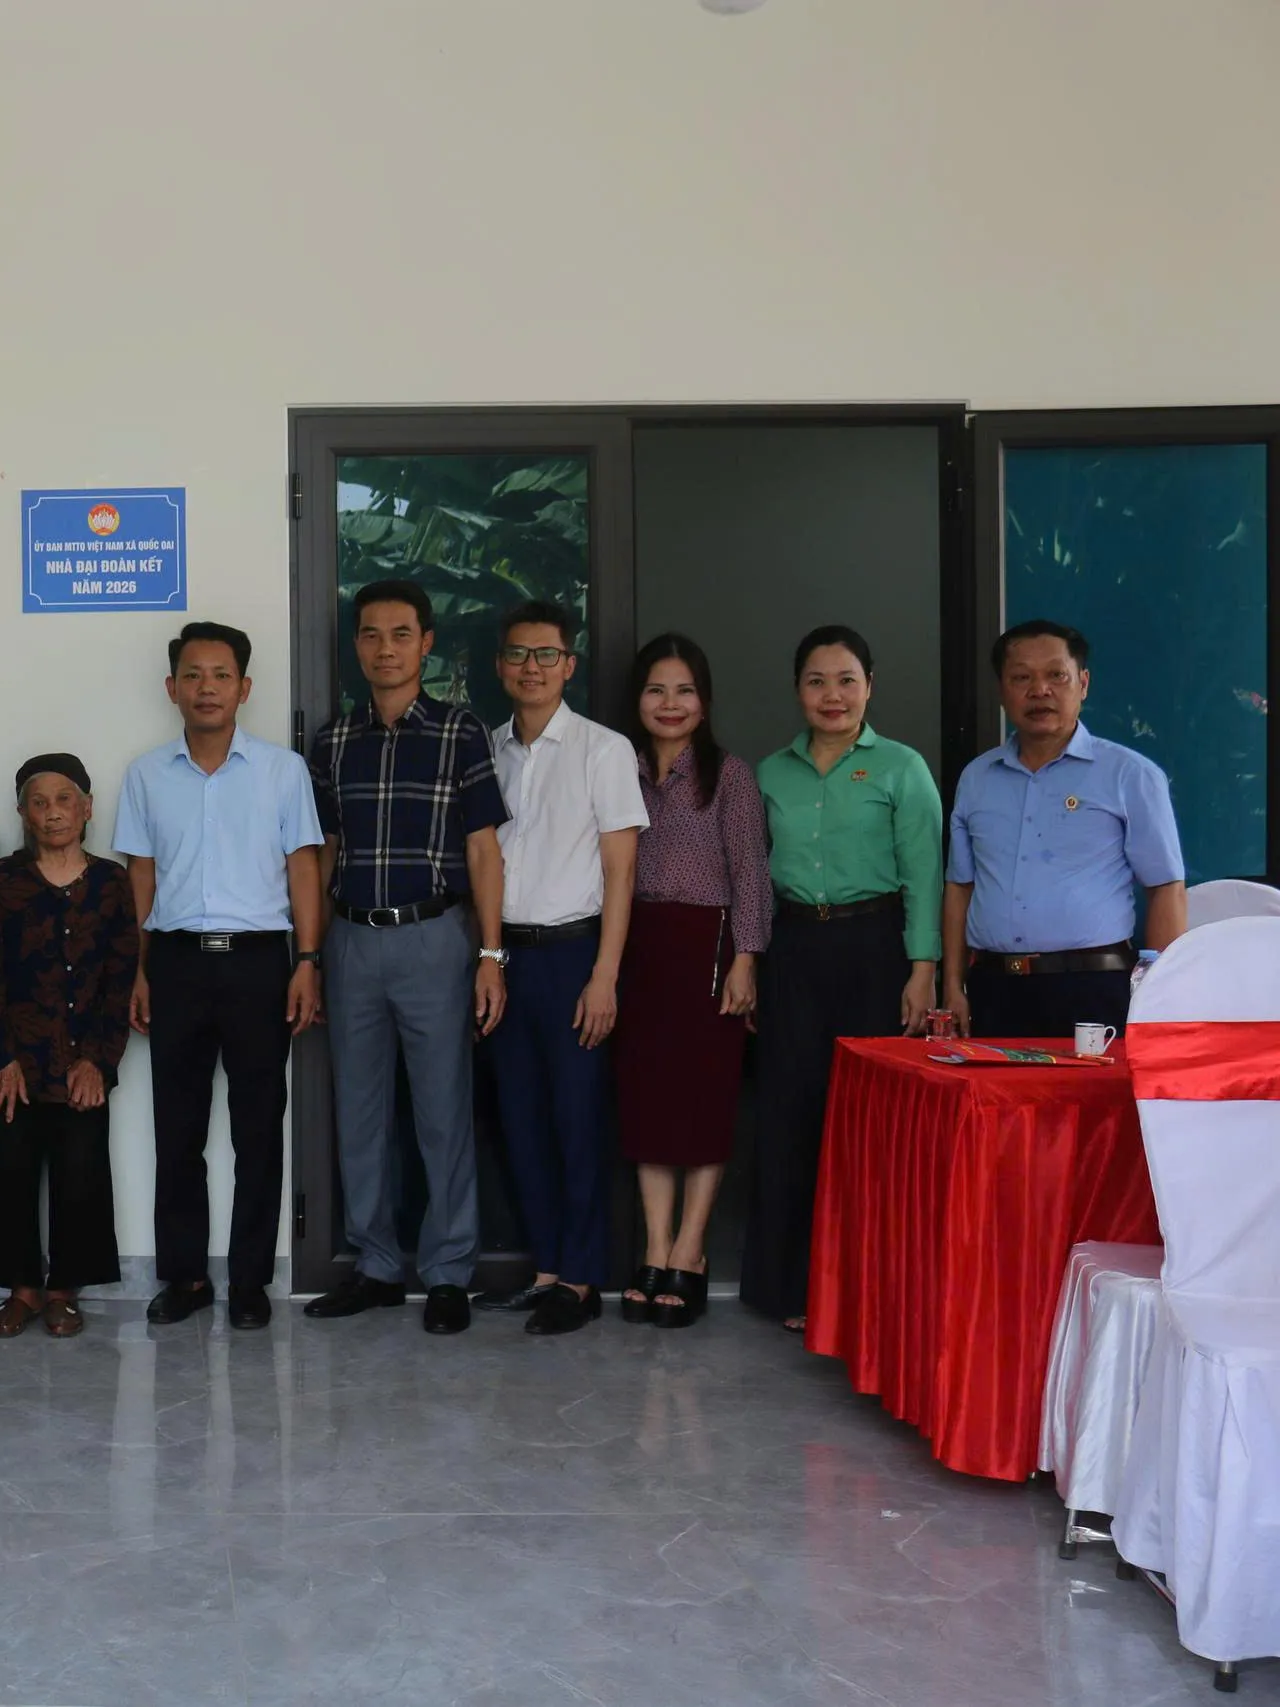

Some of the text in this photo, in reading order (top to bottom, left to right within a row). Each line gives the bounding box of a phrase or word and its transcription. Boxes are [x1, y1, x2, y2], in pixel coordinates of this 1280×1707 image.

[46, 542, 63, 552] BAN
[64, 542, 86, 552] MTTQ
[87, 540, 104, 553] VIỆT
[105, 541, 123, 551] NAM
[138, 538, 159, 551] QUỐC
[161, 541, 174, 550] OAI
[46, 555, 163, 576] NHÀ ĐẠI ĐOÀN KẾT
[72, 579, 137, 595] NĂM 2026
